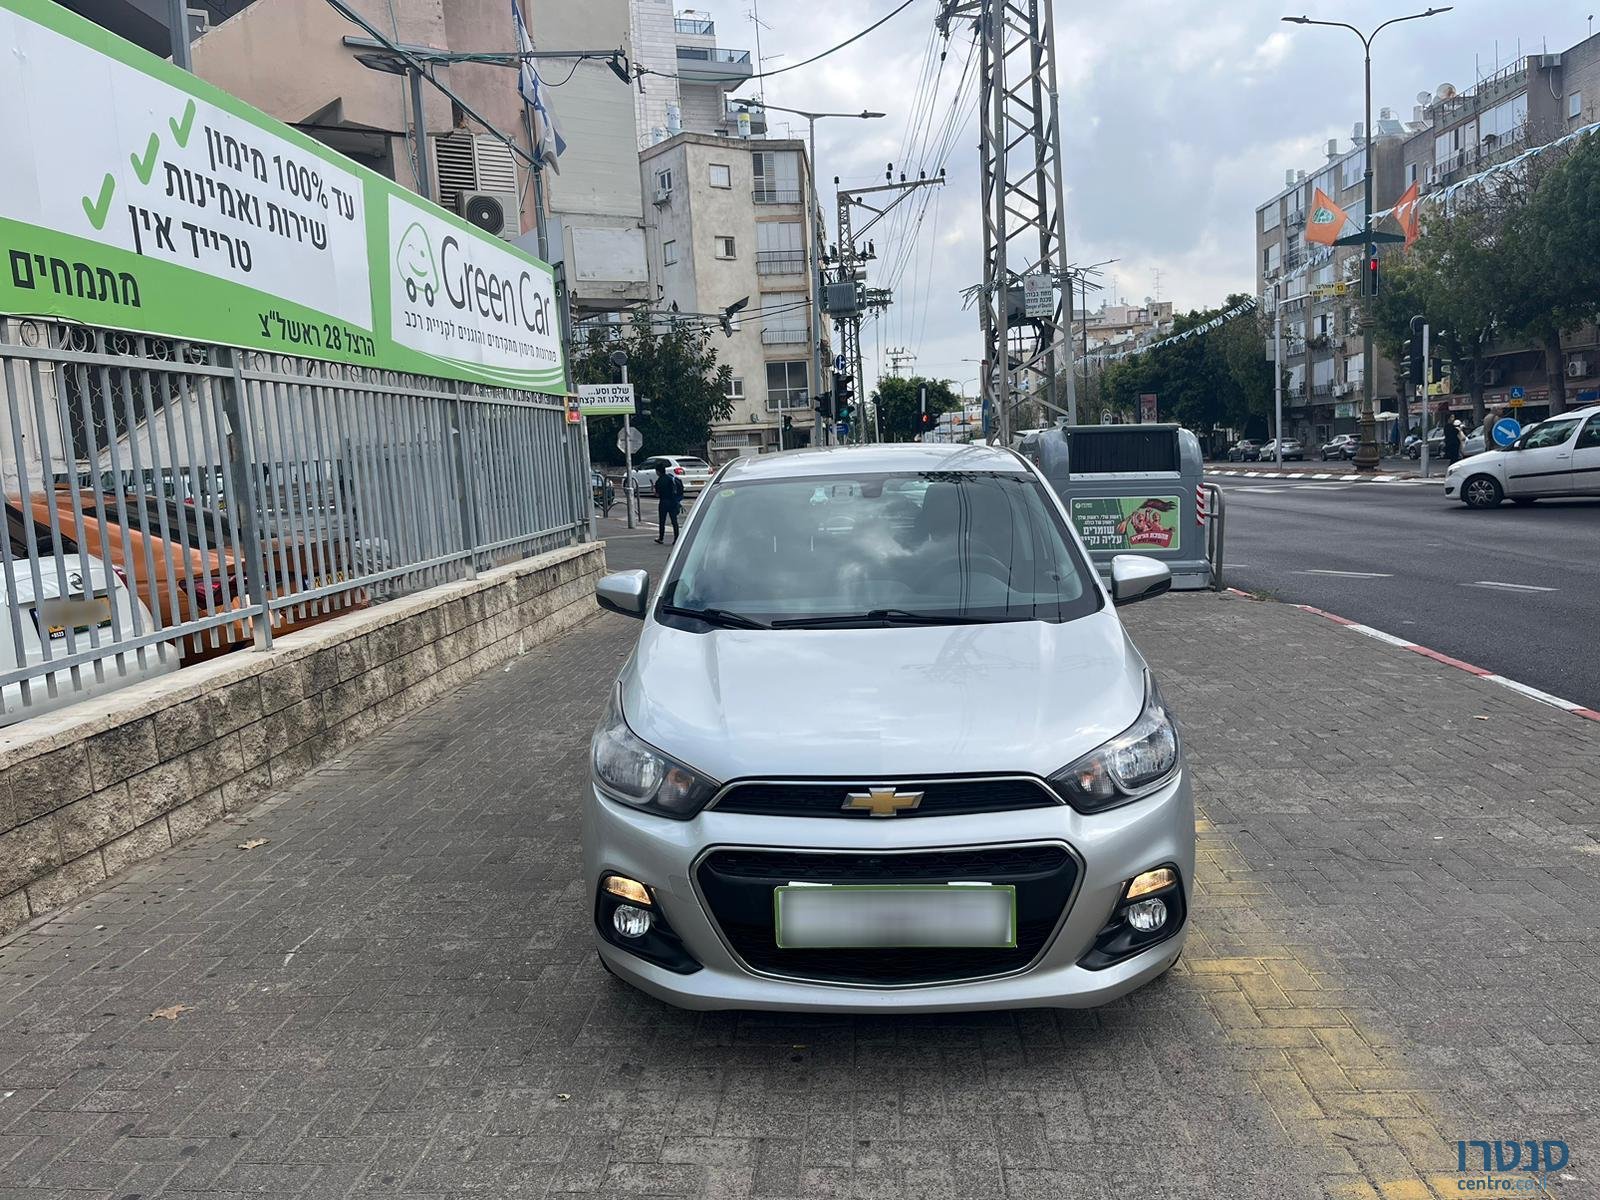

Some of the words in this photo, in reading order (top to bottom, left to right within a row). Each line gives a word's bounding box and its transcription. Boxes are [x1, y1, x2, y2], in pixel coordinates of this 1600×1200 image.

[204, 125, 268, 184] מימון
[162, 160, 262, 228] ואמינות
[273, 155, 328, 210] 100%
[331, 186, 354, 221] עד
[128, 204, 176, 256] אין
[266, 201, 327, 250] שירות
[182, 221, 252, 272] טרייד
[8, 249, 141, 308] מתמחים
[441, 235, 518, 326] Green
[519, 270, 550, 336] Car
[404, 311, 424, 330] רכב
[426, 316, 454, 340] לקניית
[323, 324, 342, 350] 28
[344, 326, 376, 357] הרצל
[458, 326, 486, 345] והוגנים
[487, 334, 518, 354] מתקדמים
[518, 342, 534, 358] מימון
[608, 395, 630, 403] אצלנו
[612, 386, 630, 394] שלם
[1083, 526, 1114, 535] שומרים
[1102, 535, 1122, 544] עליה
